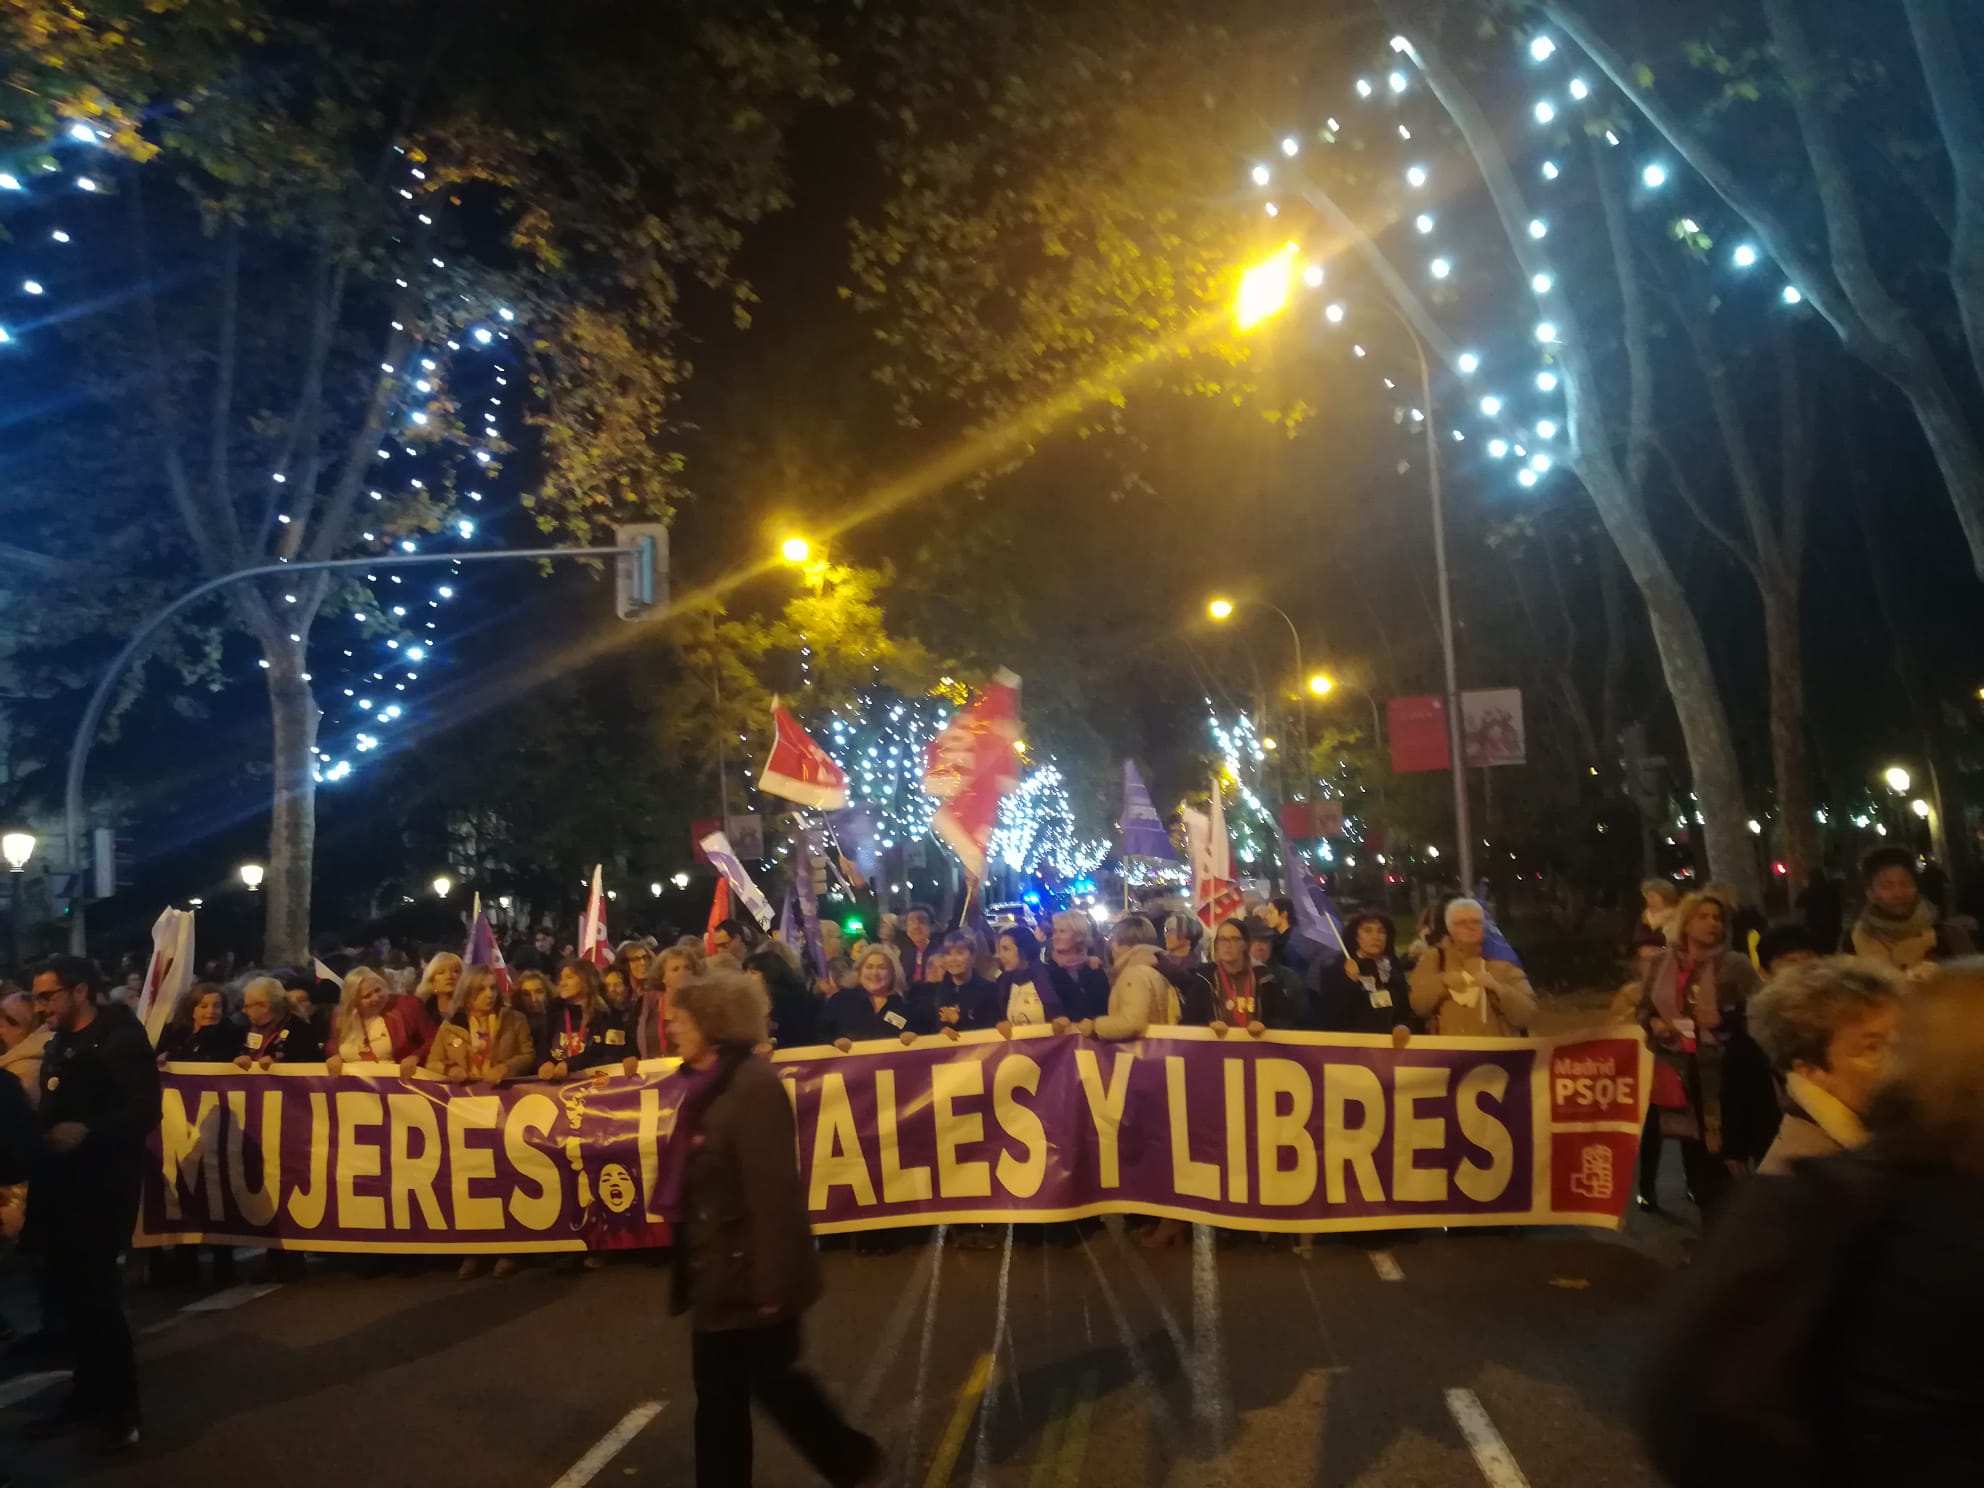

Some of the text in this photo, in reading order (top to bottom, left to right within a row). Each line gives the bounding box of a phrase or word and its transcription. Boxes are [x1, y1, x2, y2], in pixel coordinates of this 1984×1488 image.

[1553, 1056, 1616, 1076] Madrid
[1554, 1077, 1634, 1109] PSOE
[161, 1049, 1514, 1232] MUJERES IALES Y LIBRES
